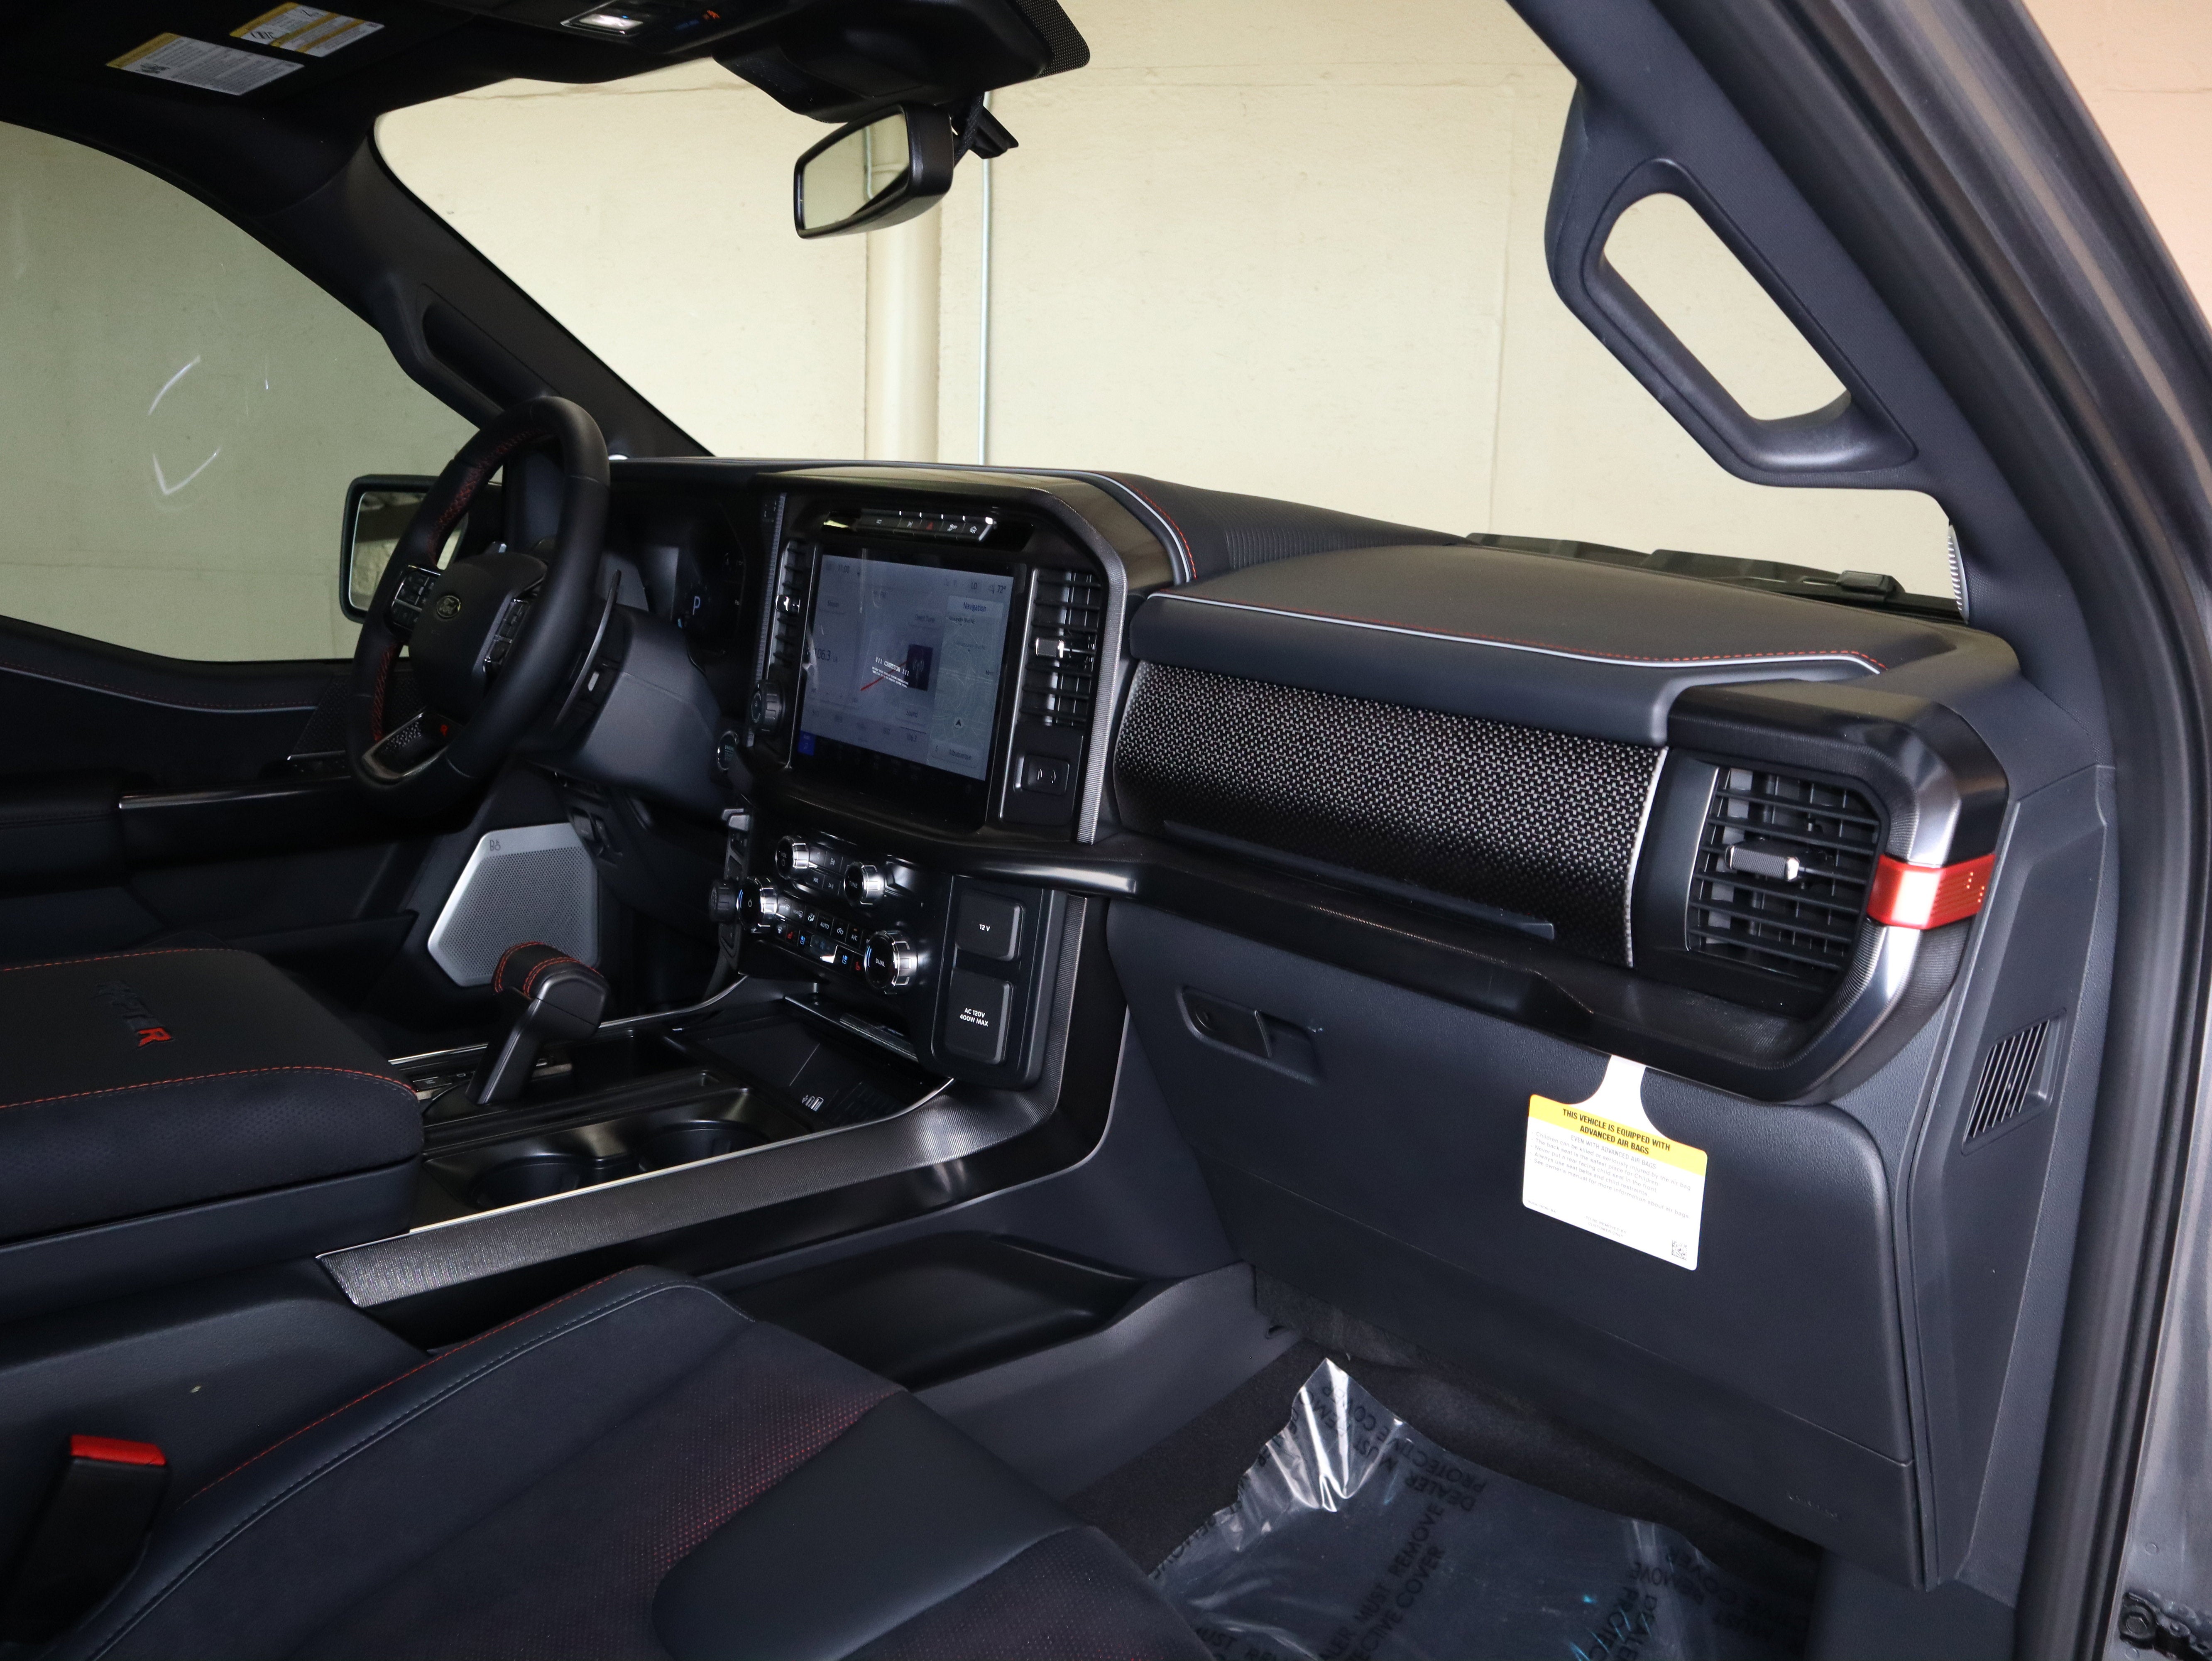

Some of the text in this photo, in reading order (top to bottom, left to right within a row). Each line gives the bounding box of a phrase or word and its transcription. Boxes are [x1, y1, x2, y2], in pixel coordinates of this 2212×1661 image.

[692, 595, 701, 615] P
[963, 602, 986, 612] Navigation
[883, 661, 901, 673] CAUTION
[820, 921, 830, 930] AUTO
[875, 958, 886, 968] DUAL
[959, 1014, 989, 1027] 400W MAX
[972, 1010, 986, 1018] 120V
[1563, 1108, 1670, 1151] THIS VEHICLE IS EQUIPPED WITH
[1579, 1125, 1649, 1155] ADVANCED AIR BAGS
[1571, 1135, 1584, 1144] EVEN
[1586, 1141, 1599, 1149] WITH
[1601, 1146, 1629, 1159] ADVANCED
[1642, 1159, 1656, 1169] BAGS
[1405, 1475, 1476, 1512] DEALER
[1353, 1583, 1391, 1621] MUST
[1388, 1503, 1445, 1578] REMOVE
[1396, 1545, 1446, 1609] COVER
[1616, 1593, 1657, 1661] DEALE
